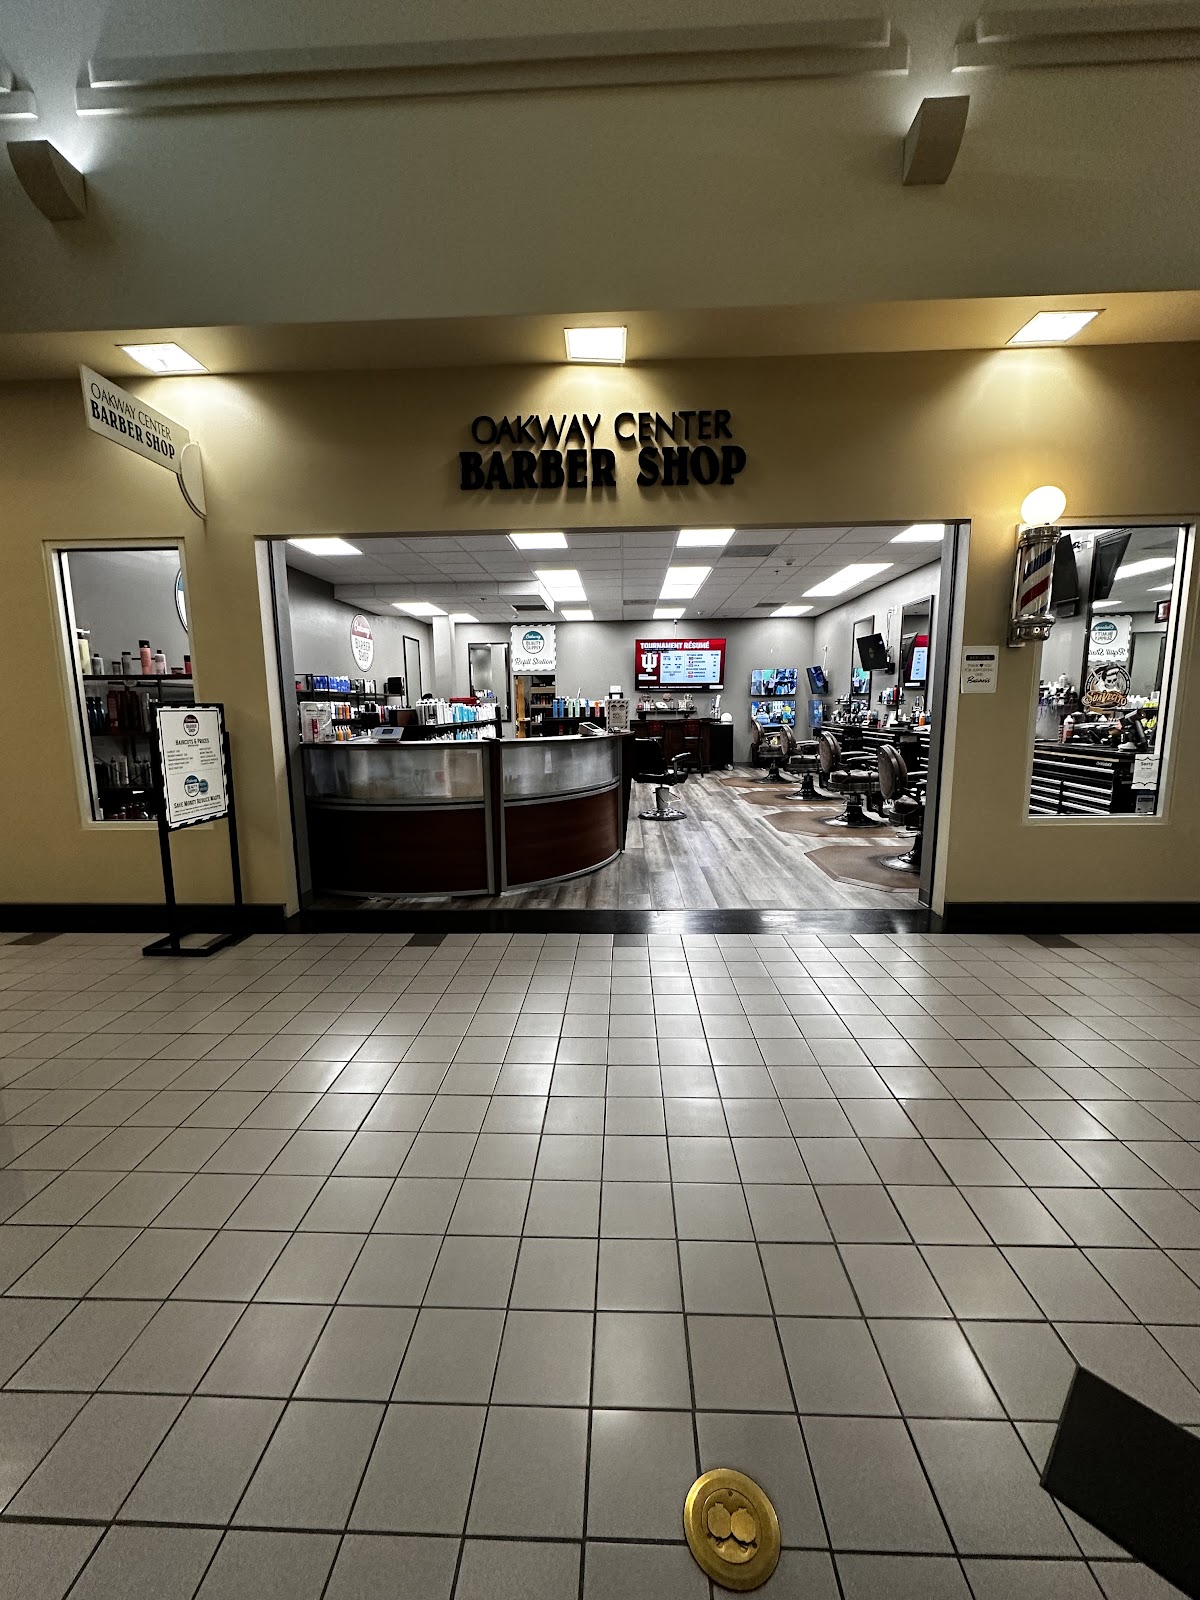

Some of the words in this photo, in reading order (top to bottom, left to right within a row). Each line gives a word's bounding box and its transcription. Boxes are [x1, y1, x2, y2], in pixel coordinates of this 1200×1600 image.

[90, 382, 136, 420] OAKWAY
[138, 410, 172, 441] CENTER
[90, 399, 144, 444] BARBER
[146, 431, 175, 459] SHOP
[471, 413, 601, 445] OAKWAY
[614, 409, 733, 442] CENTER
[459, 448, 617, 491] BARBER
[636, 444, 747, 487] SHOP
[532, 657, 553, 666] Station
[640, 642, 683, 650] TOURNAMENT
[683, 640, 710, 649] RÉSUMÉ
